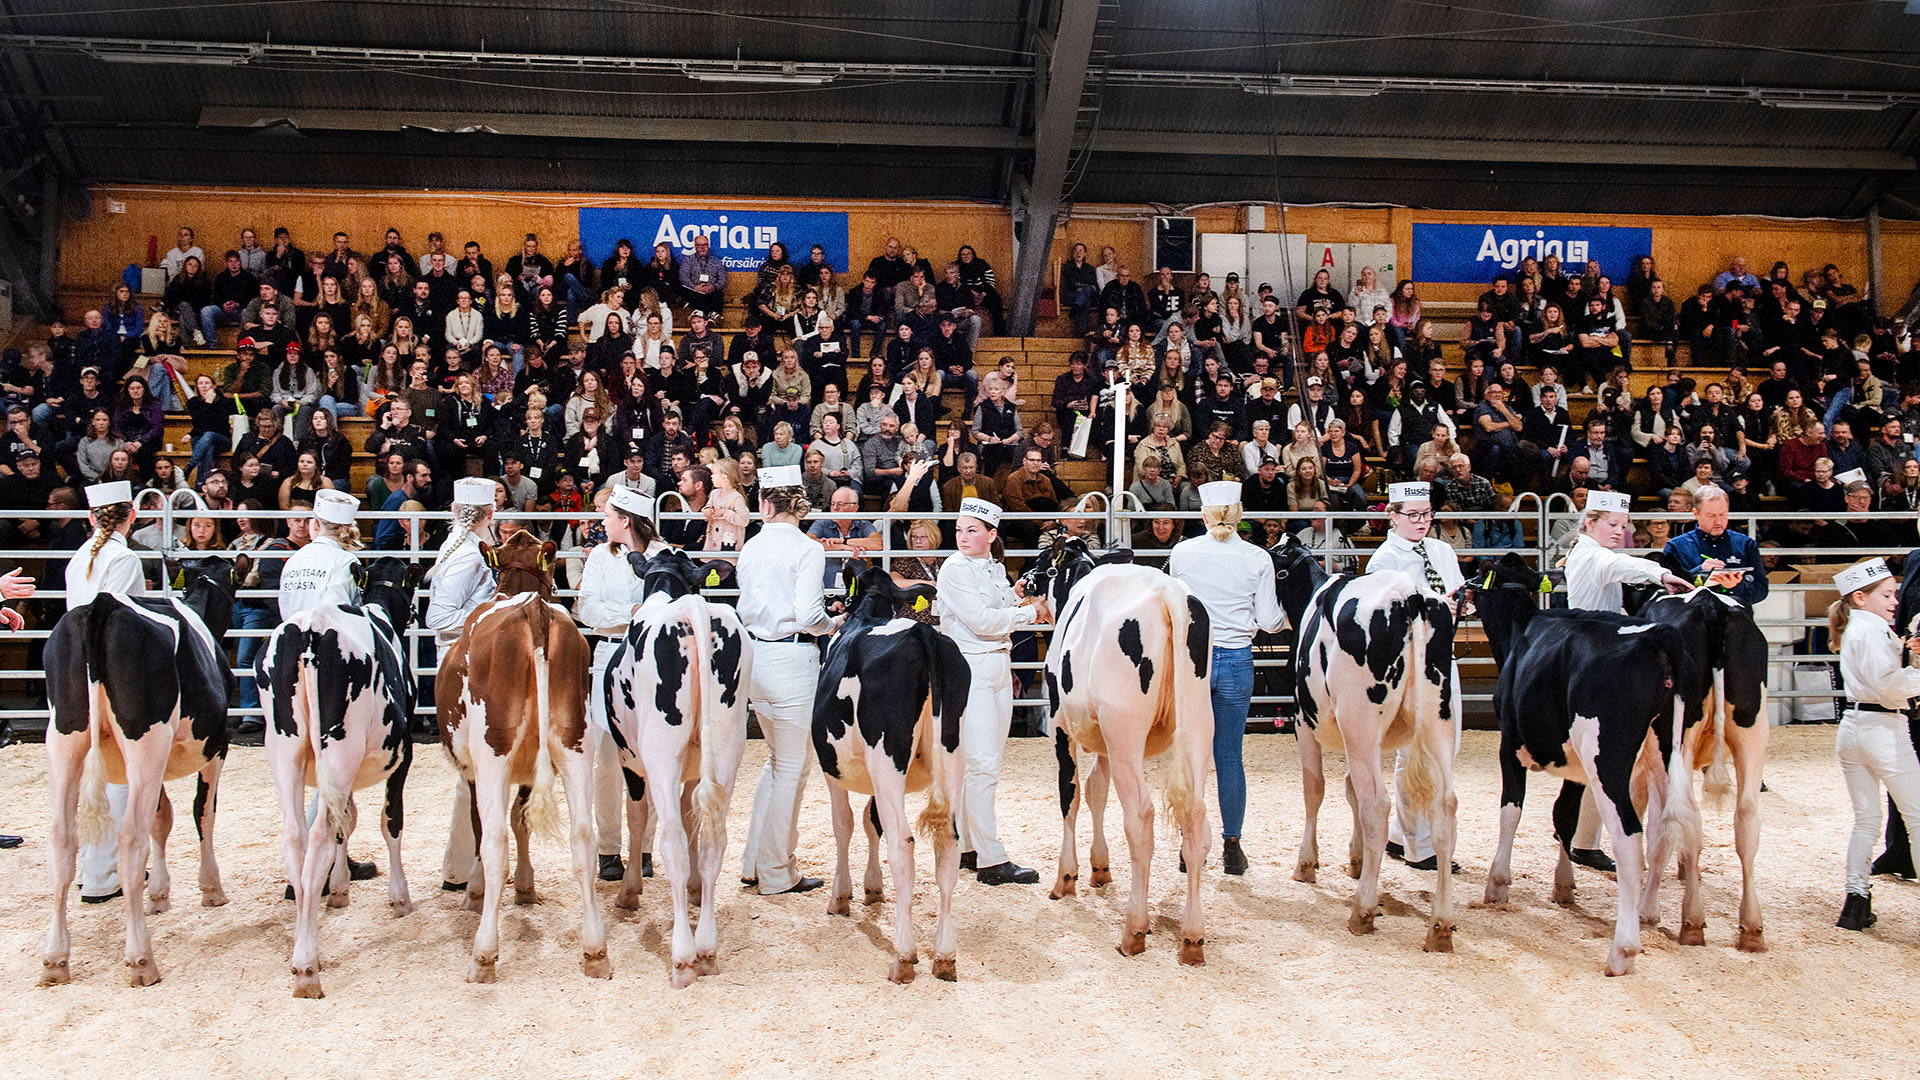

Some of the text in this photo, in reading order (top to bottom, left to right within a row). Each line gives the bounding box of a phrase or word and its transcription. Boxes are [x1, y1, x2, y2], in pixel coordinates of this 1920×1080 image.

[653, 213, 751, 256] Agria
[1476, 229, 1564, 269] Agria
[1321, 247, 1335, 268] A
